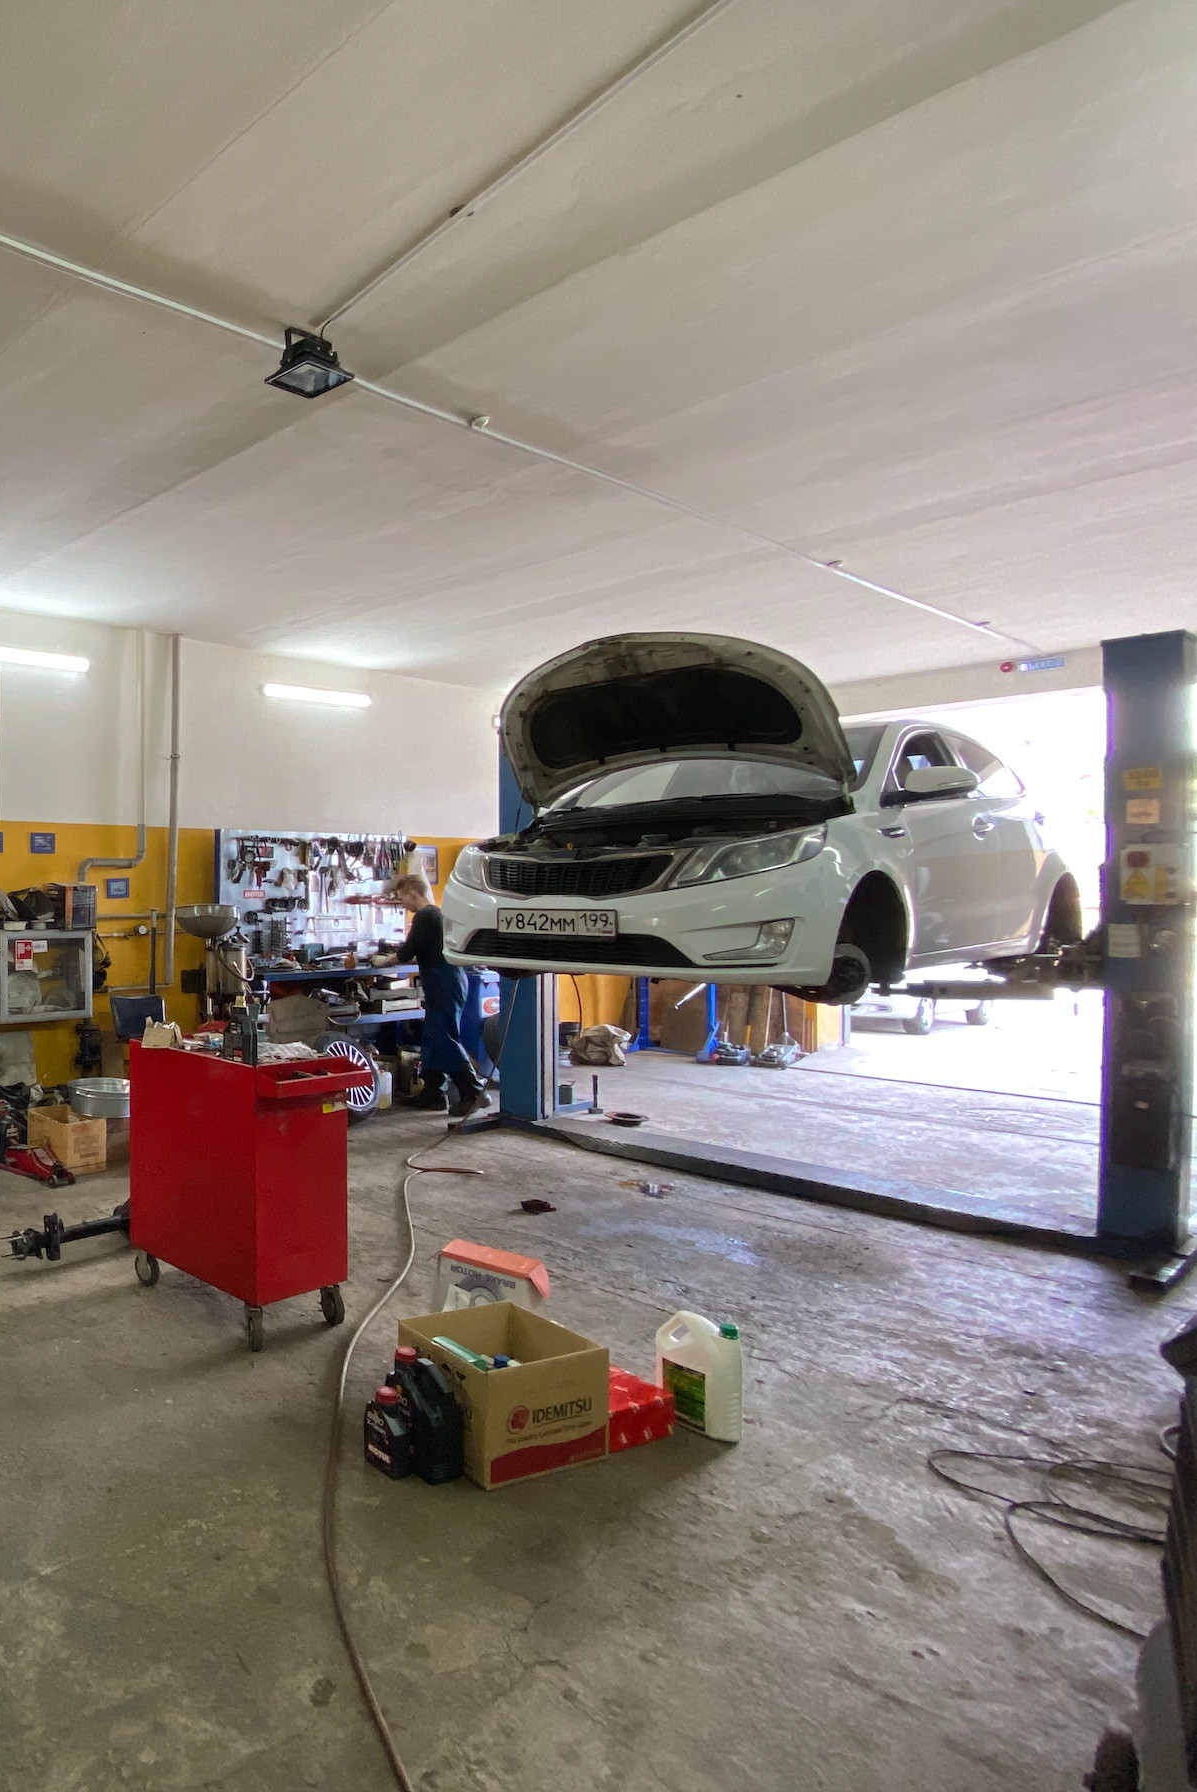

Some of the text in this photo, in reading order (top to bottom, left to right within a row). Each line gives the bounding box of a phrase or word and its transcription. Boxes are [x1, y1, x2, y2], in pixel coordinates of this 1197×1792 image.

[579, 912, 609, 928] 199
[450, 1264, 482, 1279] ROTOR
[531, 1397, 592, 1423] IDEMITSU
